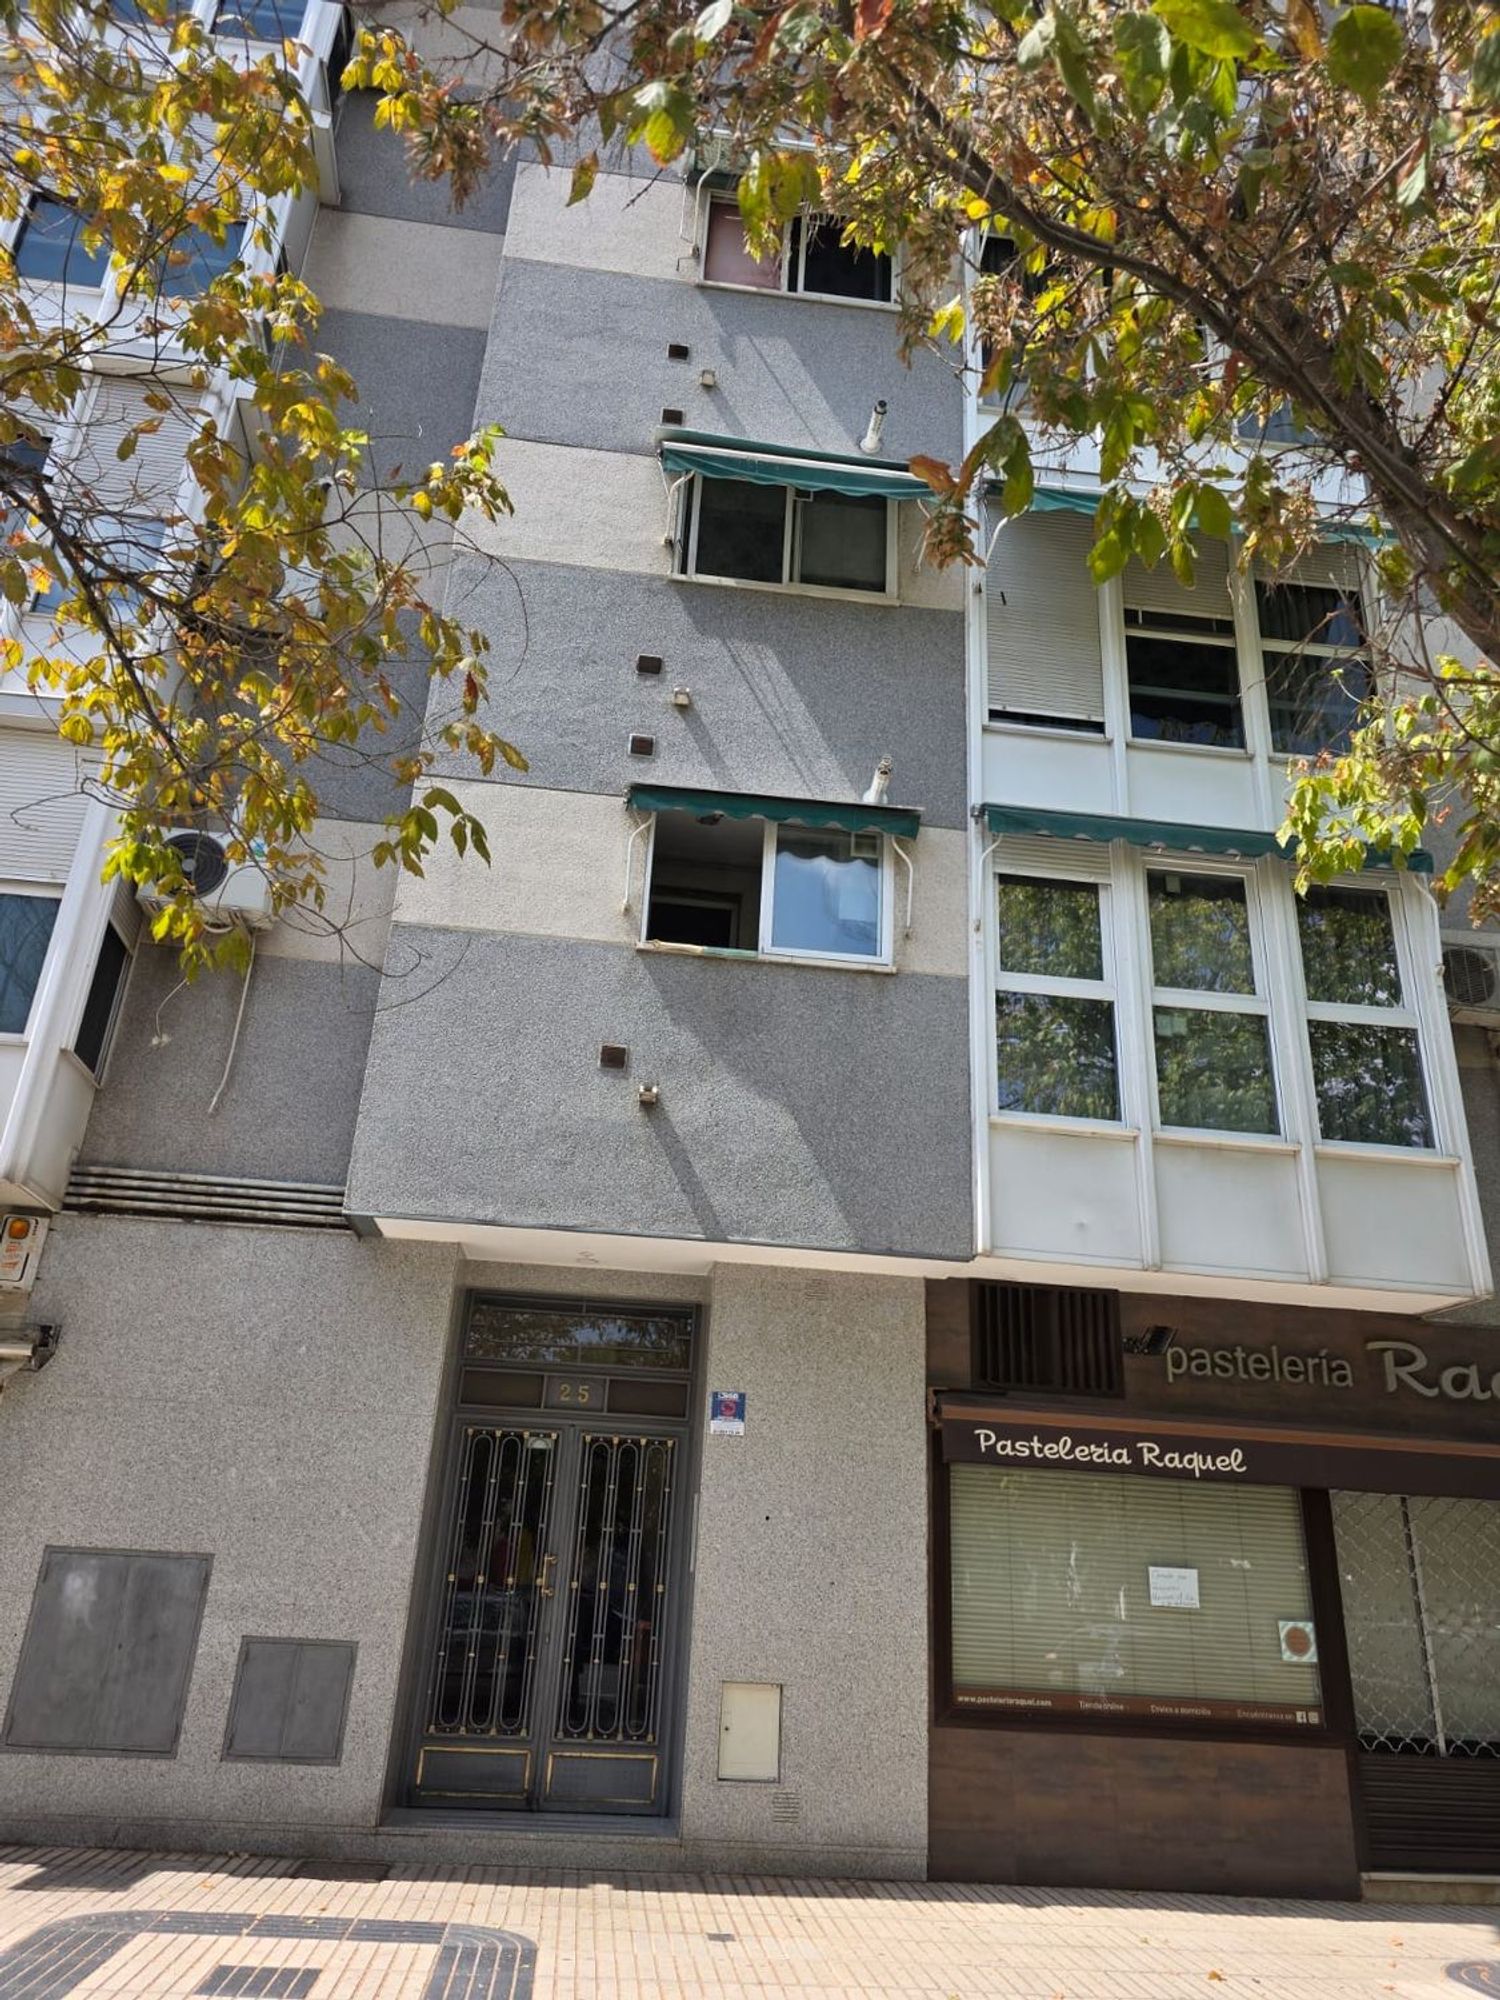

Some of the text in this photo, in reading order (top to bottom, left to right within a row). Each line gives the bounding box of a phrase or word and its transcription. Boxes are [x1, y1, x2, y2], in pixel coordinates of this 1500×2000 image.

[1166, 1340, 1500, 1401] pastelería Ra
[560, 1384, 590, 1403] 25
[1136, 1442, 1248, 1479] Raquel
